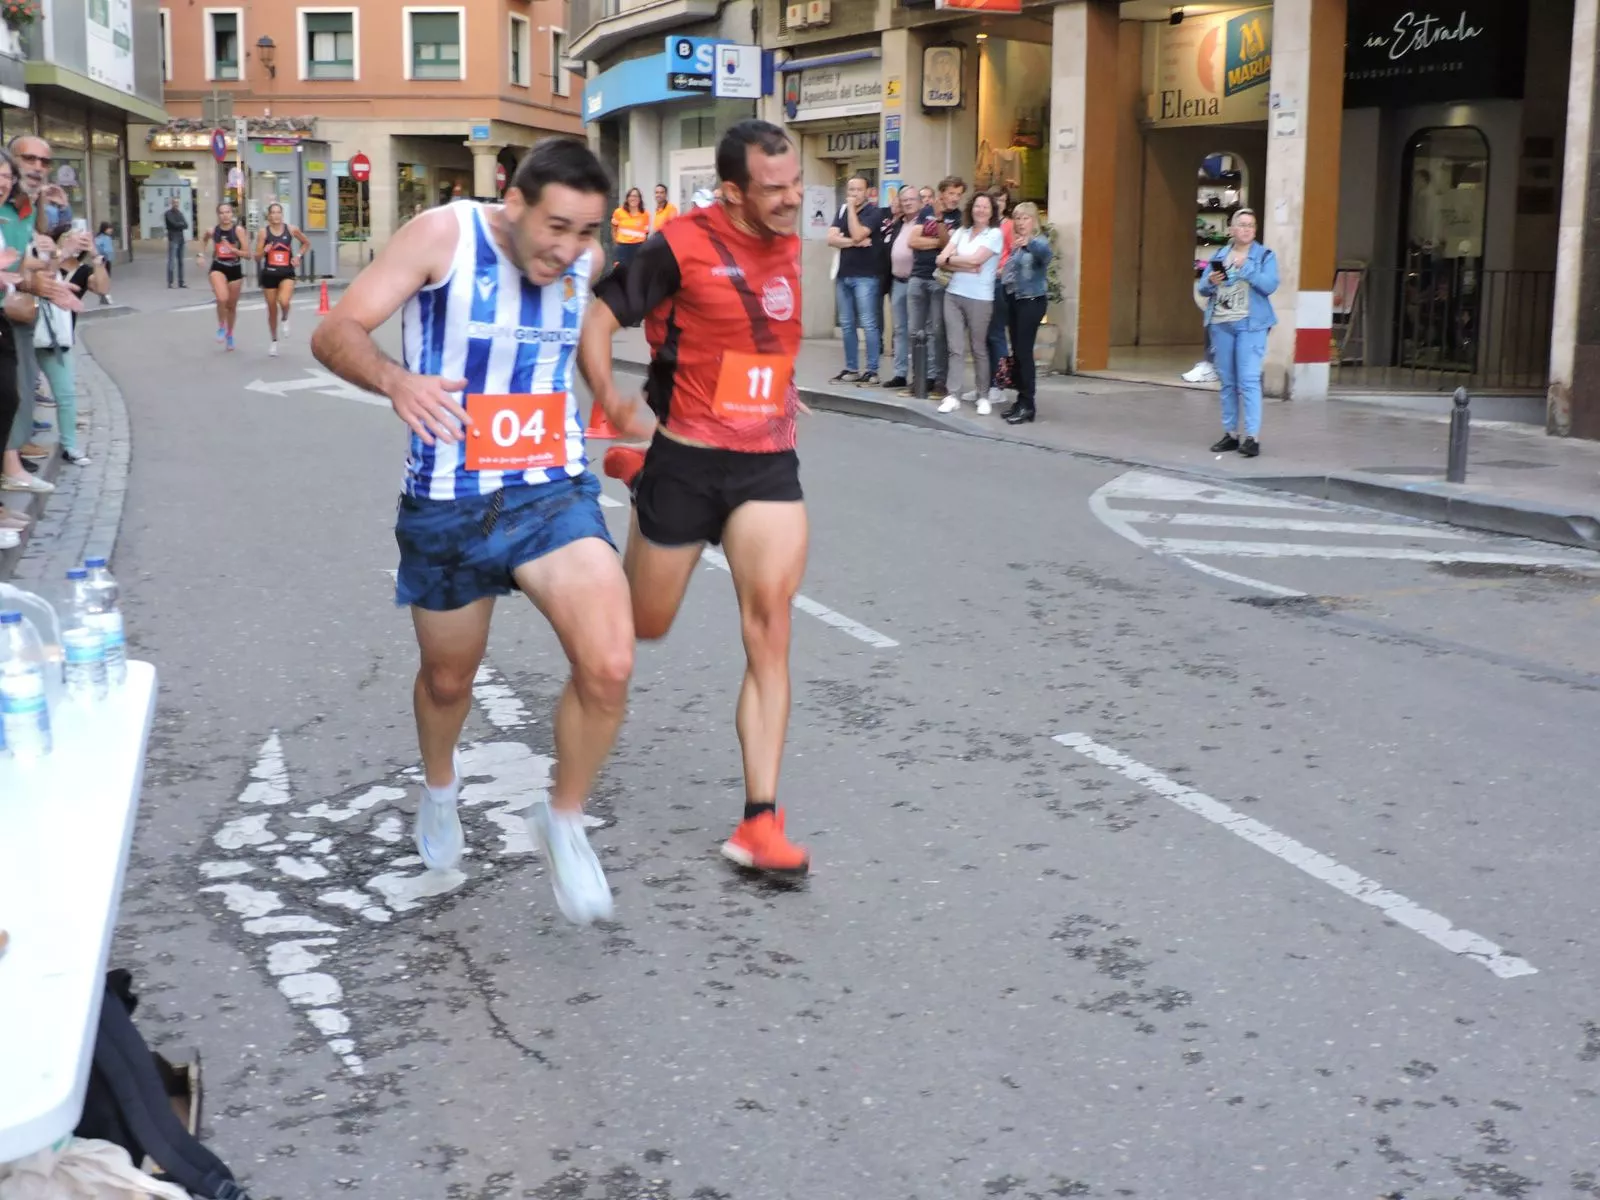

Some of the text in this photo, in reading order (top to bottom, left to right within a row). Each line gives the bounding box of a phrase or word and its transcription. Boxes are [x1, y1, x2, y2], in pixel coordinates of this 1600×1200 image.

[1388, 11, 1484, 60] Estrada
[1160, 89, 1220, 120] Elena
[747, 366, 774, 399] 11
[491, 409, 546, 448] 04
